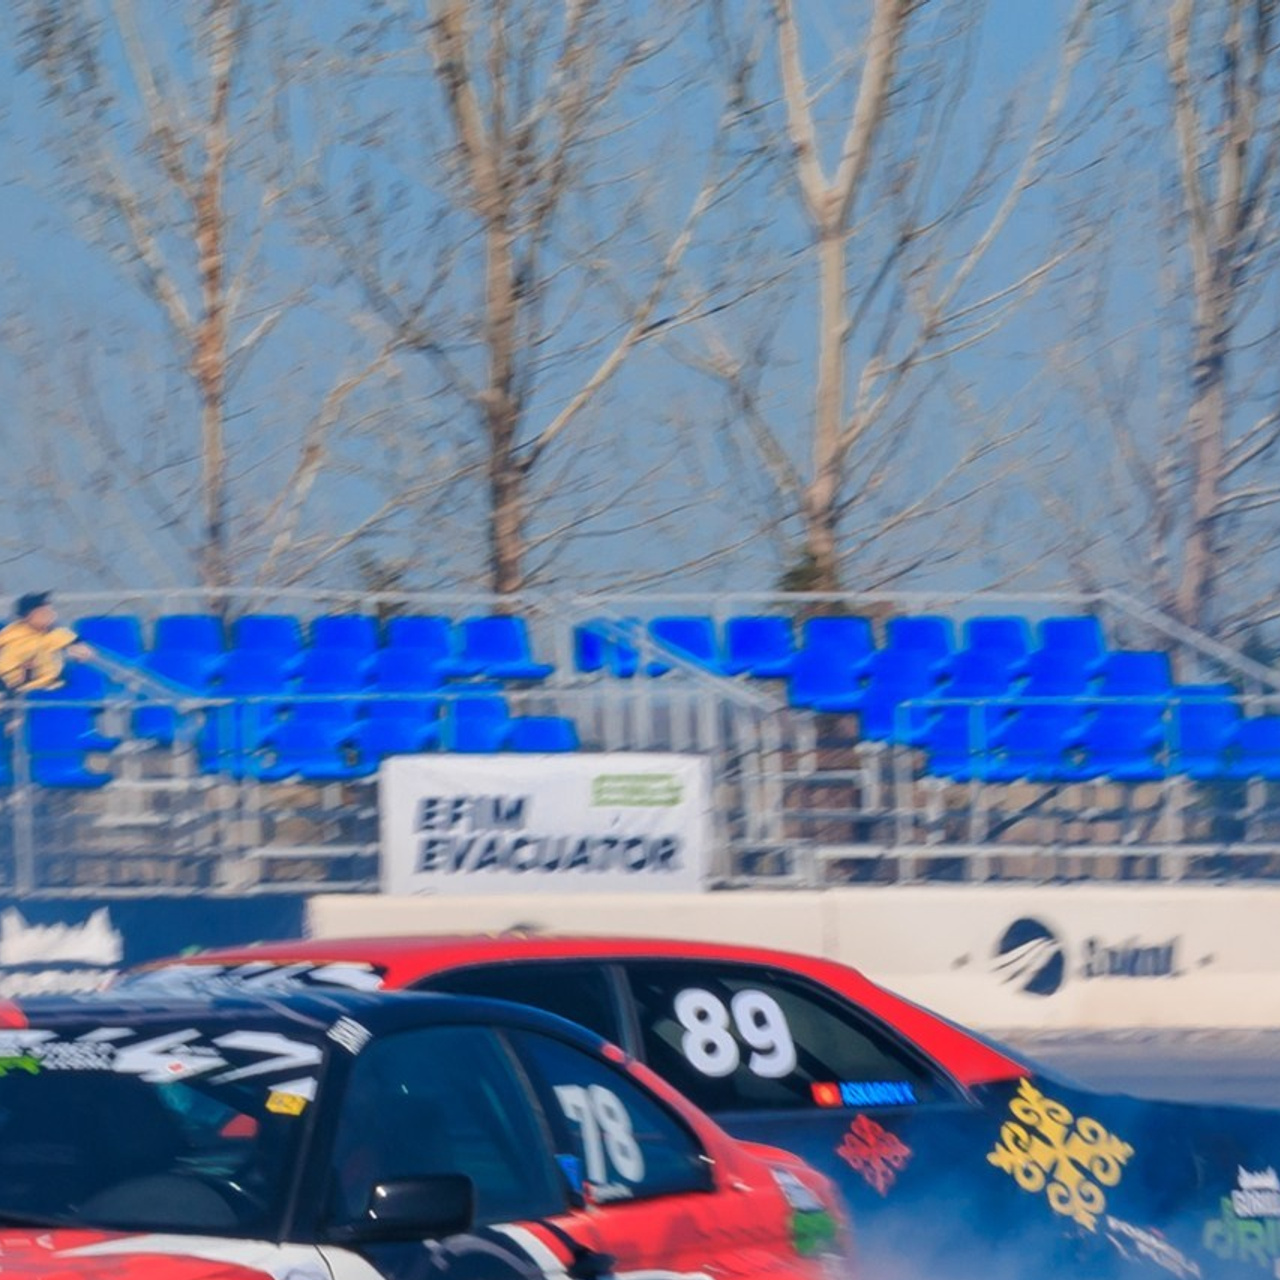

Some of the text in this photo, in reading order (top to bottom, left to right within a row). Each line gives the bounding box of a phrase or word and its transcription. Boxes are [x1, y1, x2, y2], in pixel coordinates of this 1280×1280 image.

[416, 834, 682, 874] EVACUATOR
[673, 987, 798, 1079] 89
[553, 1084, 646, 1184] 78
